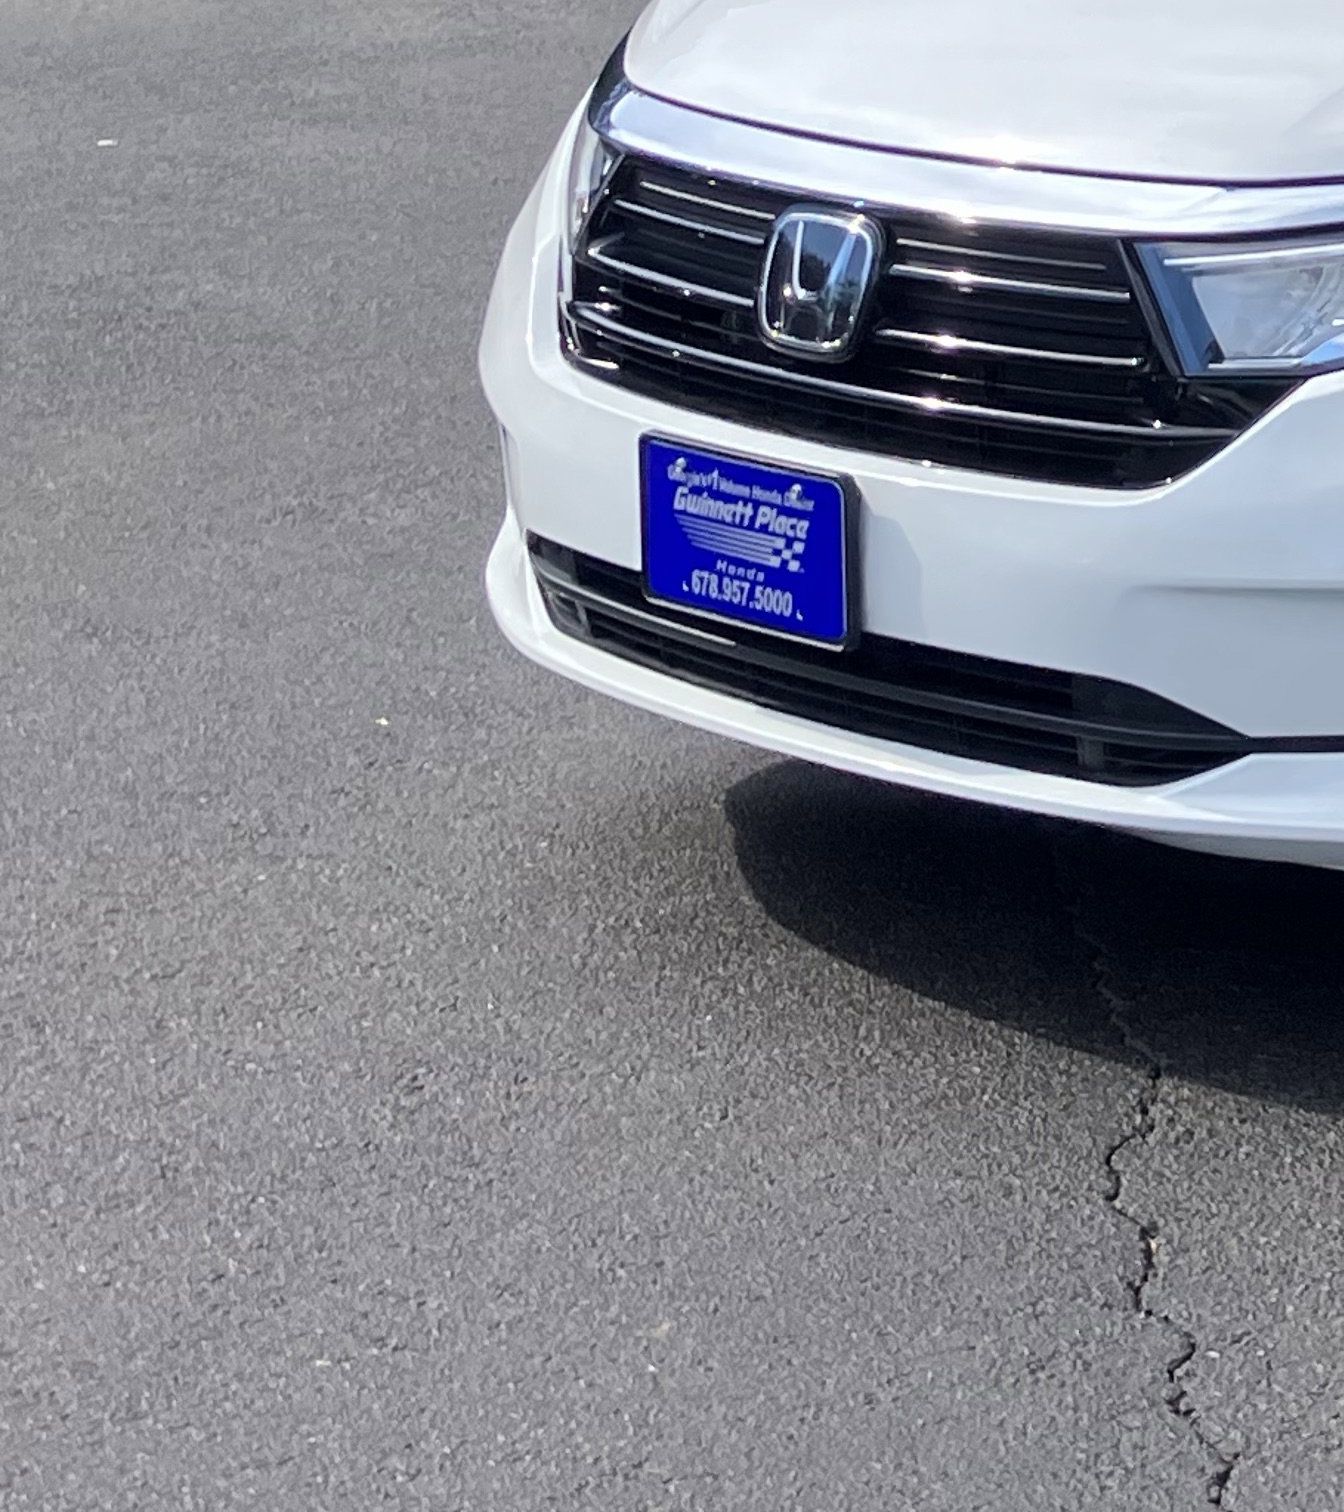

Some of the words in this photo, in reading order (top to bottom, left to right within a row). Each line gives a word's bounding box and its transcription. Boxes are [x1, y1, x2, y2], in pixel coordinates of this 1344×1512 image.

[673, 486, 754, 527] Gwinnett
[754, 505, 809, 539] Place
[691, 568, 793, 618] 678.957.5000
[716, 559, 765, 583] Honda
